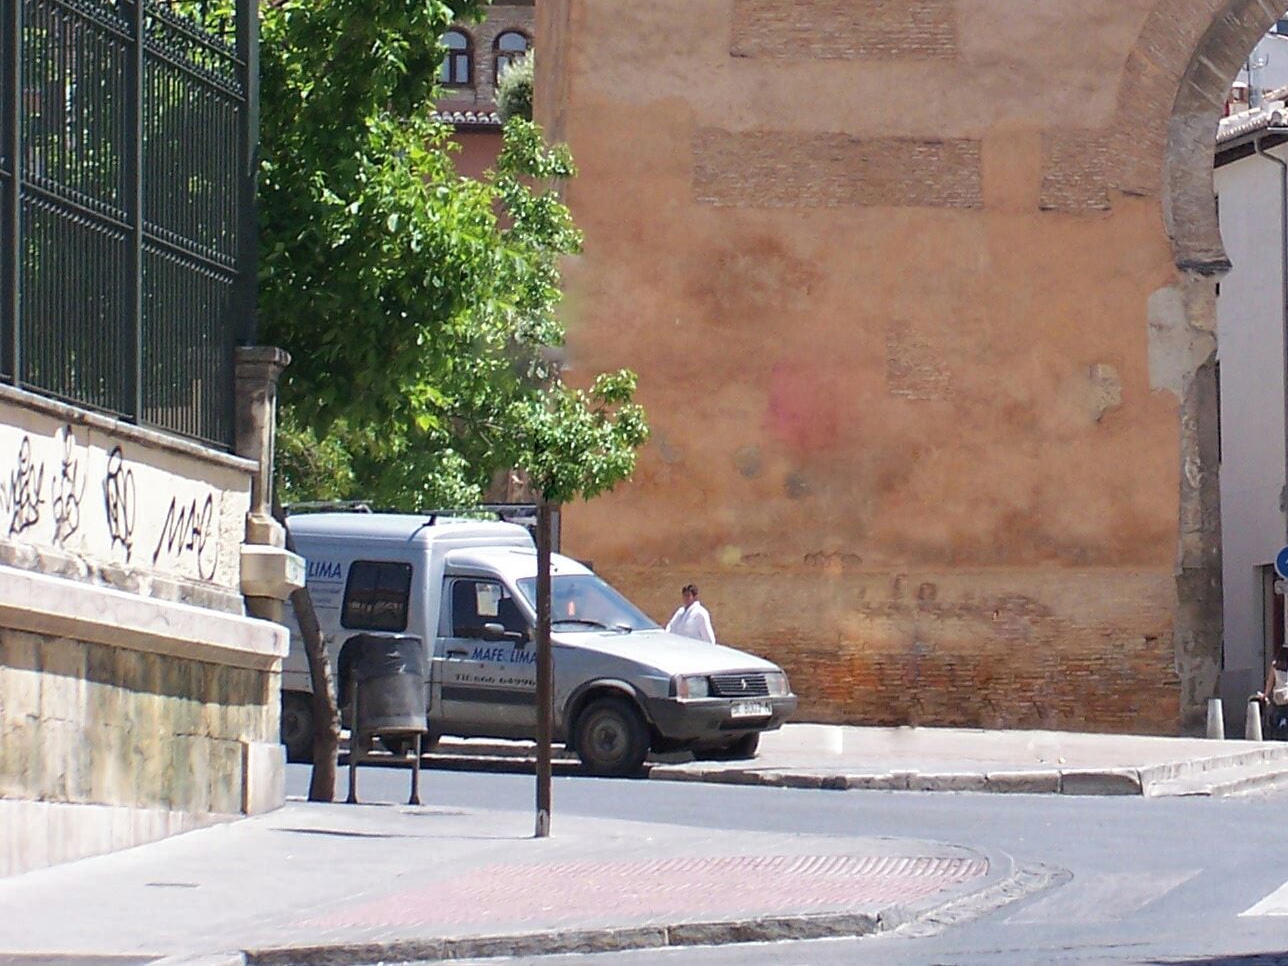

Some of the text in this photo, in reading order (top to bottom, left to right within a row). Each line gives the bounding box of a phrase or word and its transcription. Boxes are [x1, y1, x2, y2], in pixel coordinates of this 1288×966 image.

[309, 561, 342, 579] LIMA
[472, 647, 537, 665] MAFE LIMA
